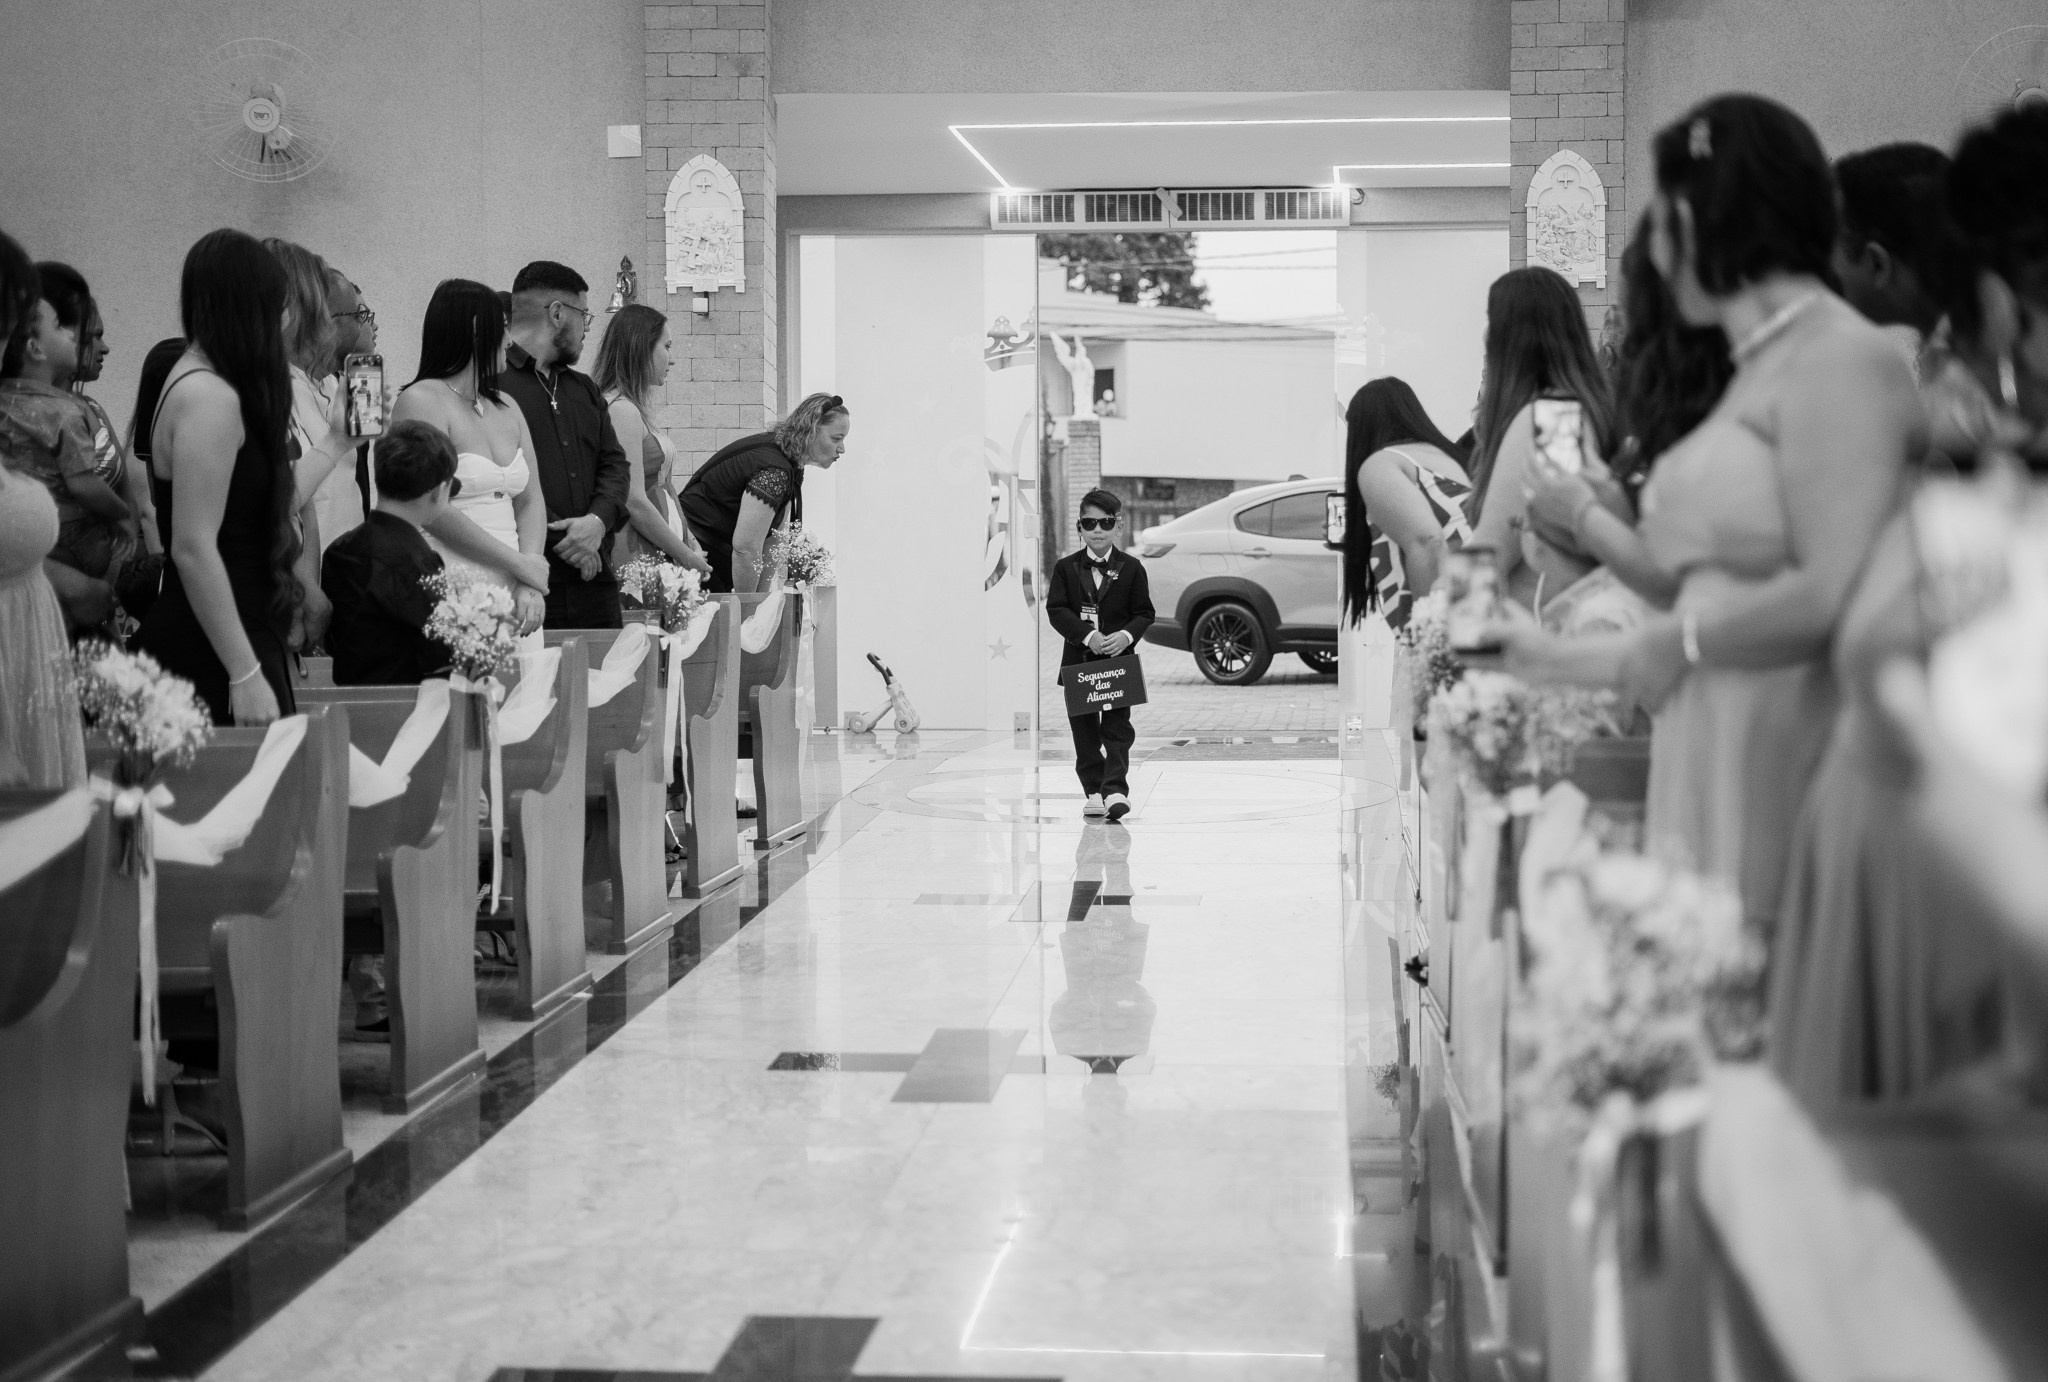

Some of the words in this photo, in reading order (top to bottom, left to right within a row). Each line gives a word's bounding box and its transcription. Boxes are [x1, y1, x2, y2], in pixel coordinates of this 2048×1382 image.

[1078, 668, 1126, 685] Segurança
[1095, 680, 1111, 690] das
[1086, 690, 1124, 703] Alianças
